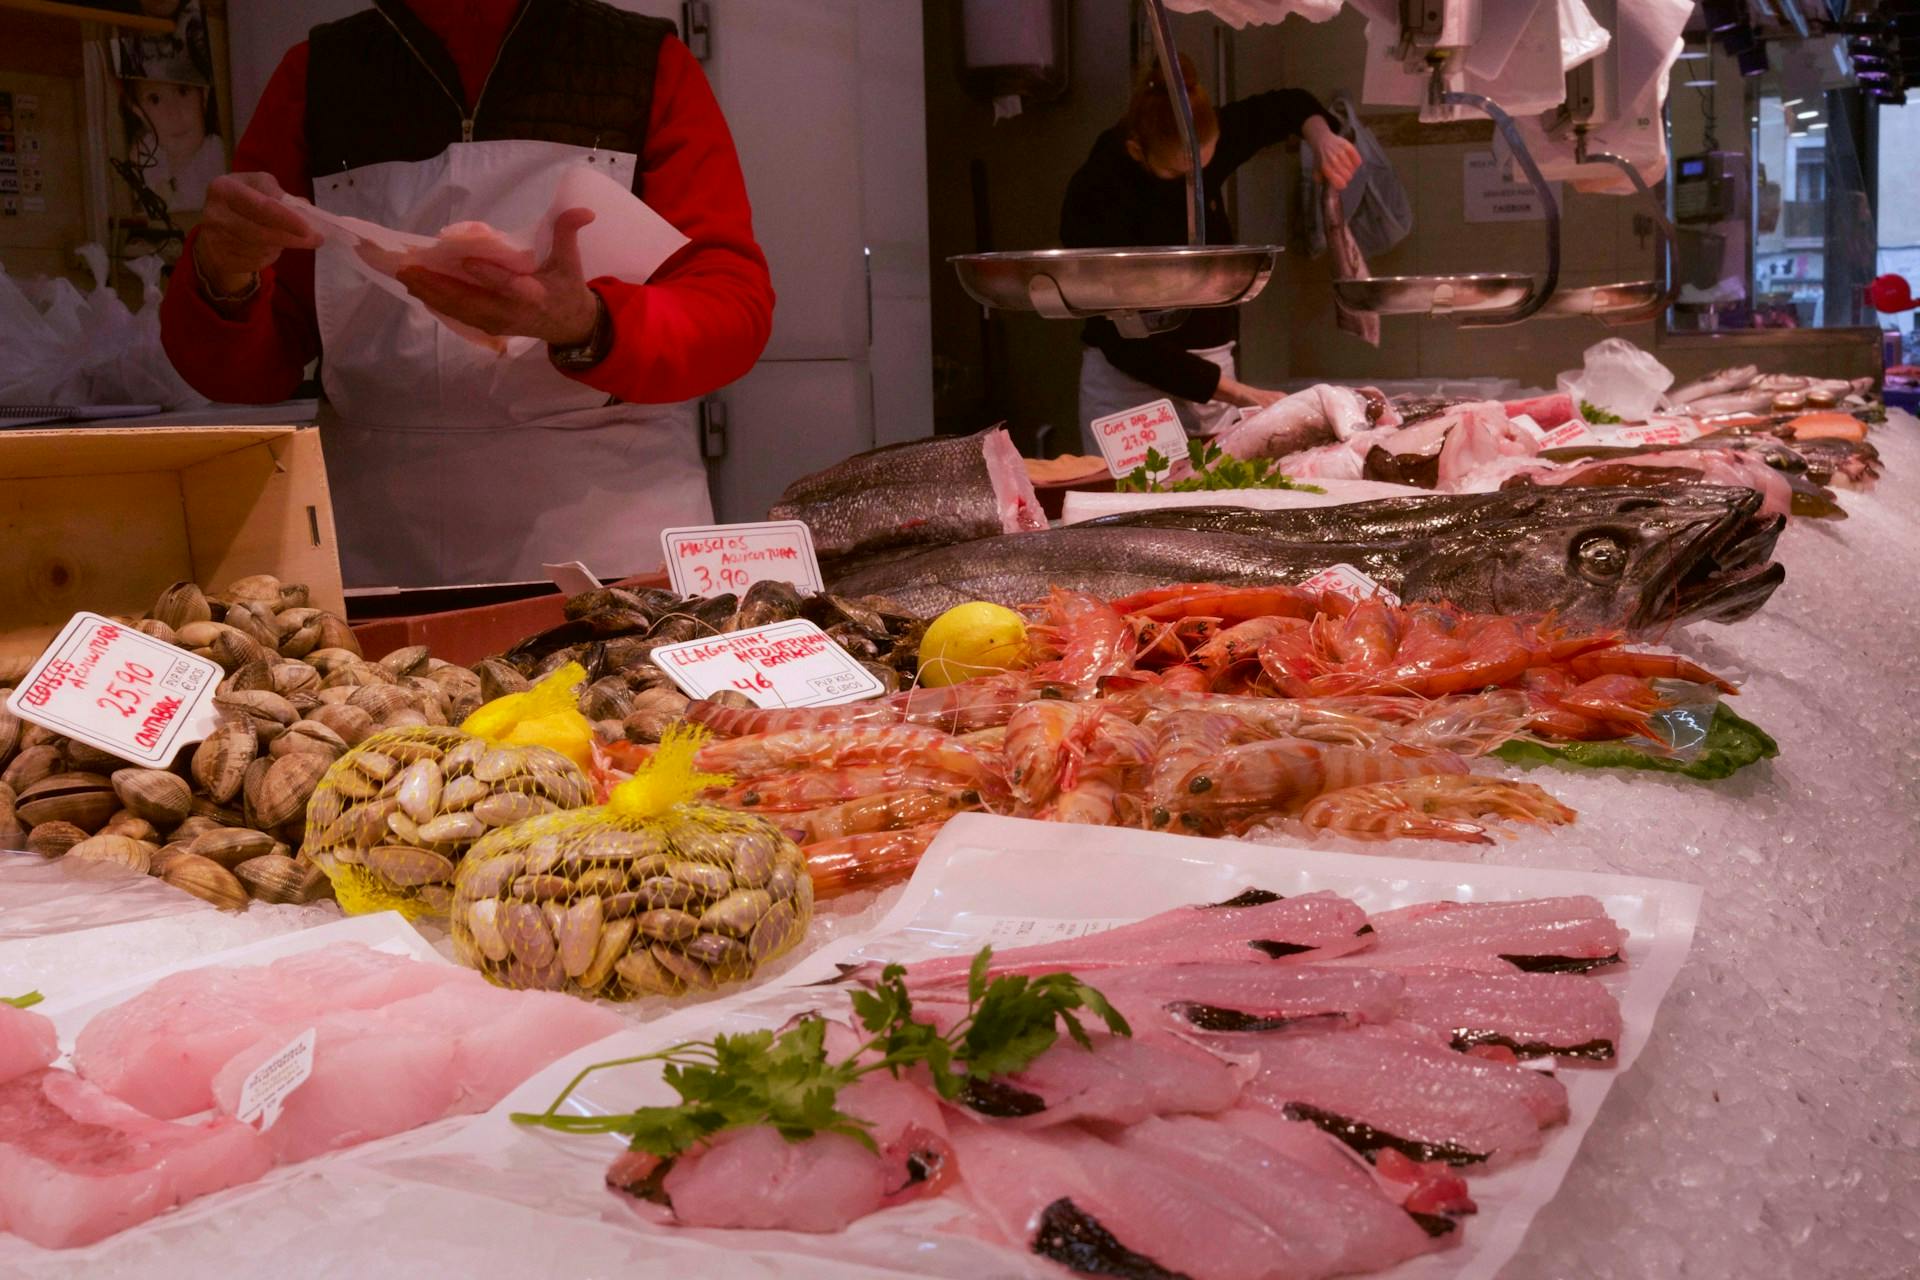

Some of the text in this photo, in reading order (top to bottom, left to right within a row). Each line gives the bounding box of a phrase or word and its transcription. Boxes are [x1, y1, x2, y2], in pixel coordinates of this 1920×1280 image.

[0, 159, 16, 168] VISA
[1, 179, 17, 188] VISA
[678, 535, 748, 559] MUSCLOS
[693, 565, 750, 593] 3,90
[671, 632, 770, 667] LLAGOSTINS
[96, 660, 156, 719] 25,90
[730, 671, 774, 695] 46
